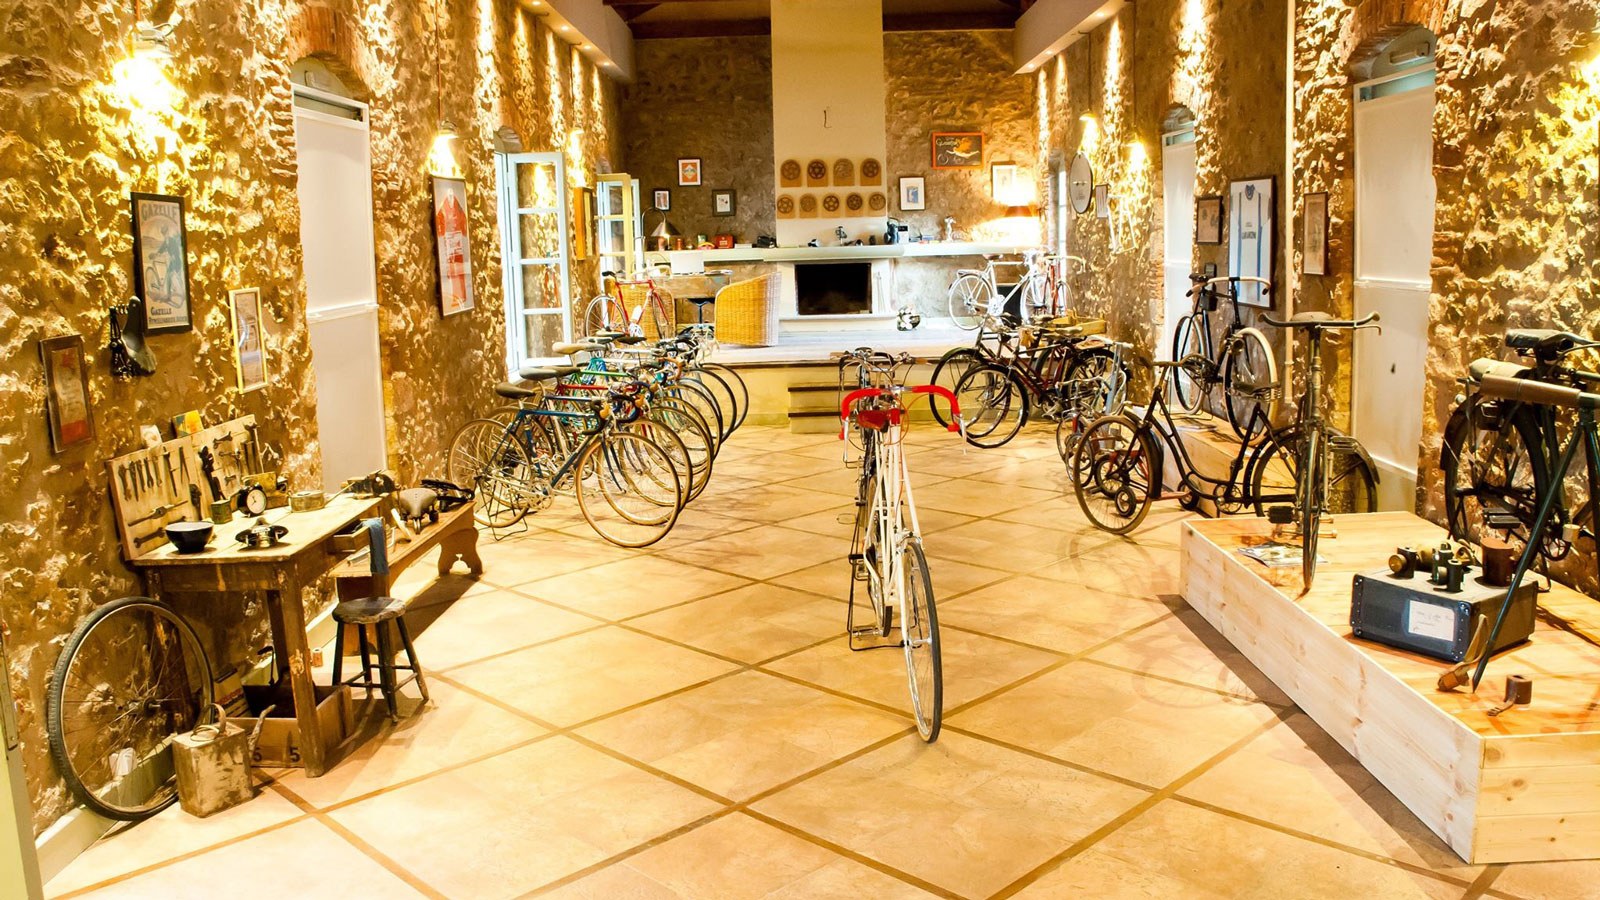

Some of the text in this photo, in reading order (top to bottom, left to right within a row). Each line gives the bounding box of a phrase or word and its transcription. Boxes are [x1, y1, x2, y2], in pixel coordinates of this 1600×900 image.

[141, 203, 179, 221] GAZELLE
[151, 306, 172, 316] GAZELLE
[290, 746, 300, 762] 5
